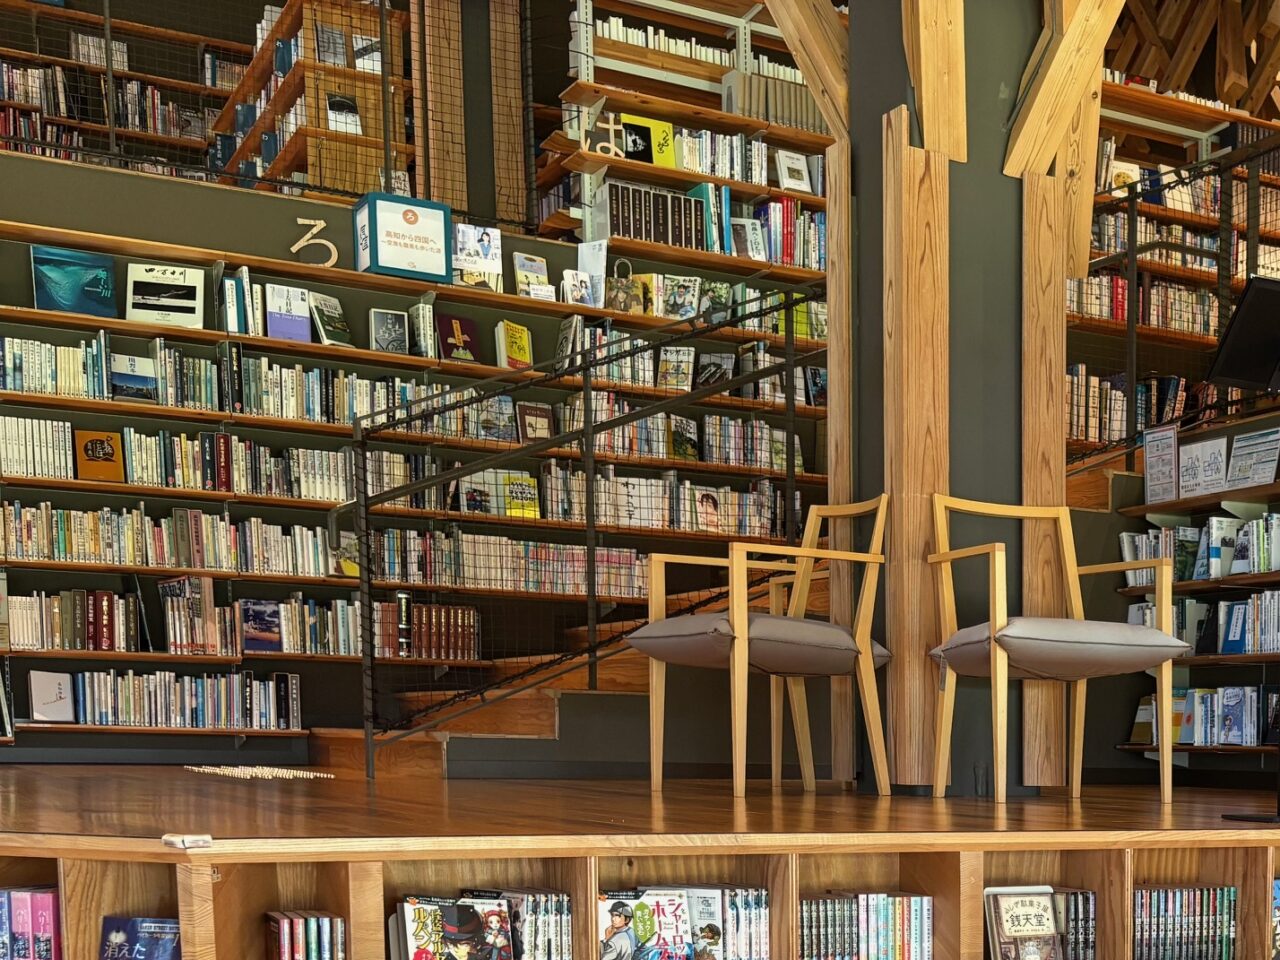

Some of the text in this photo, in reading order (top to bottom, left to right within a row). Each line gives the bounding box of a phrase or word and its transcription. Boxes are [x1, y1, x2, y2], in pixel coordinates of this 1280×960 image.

[290, 217, 338, 268] ろ
[384, 230, 437, 245] 高知から四国へ
[1004, 899, 1049, 915] ふしぎ駄菓子屋
[412, 907, 431, 949] ルパン
[1010, 913, 1047, 928] 銭天堂
[104, 941, 146, 960] 消えた
